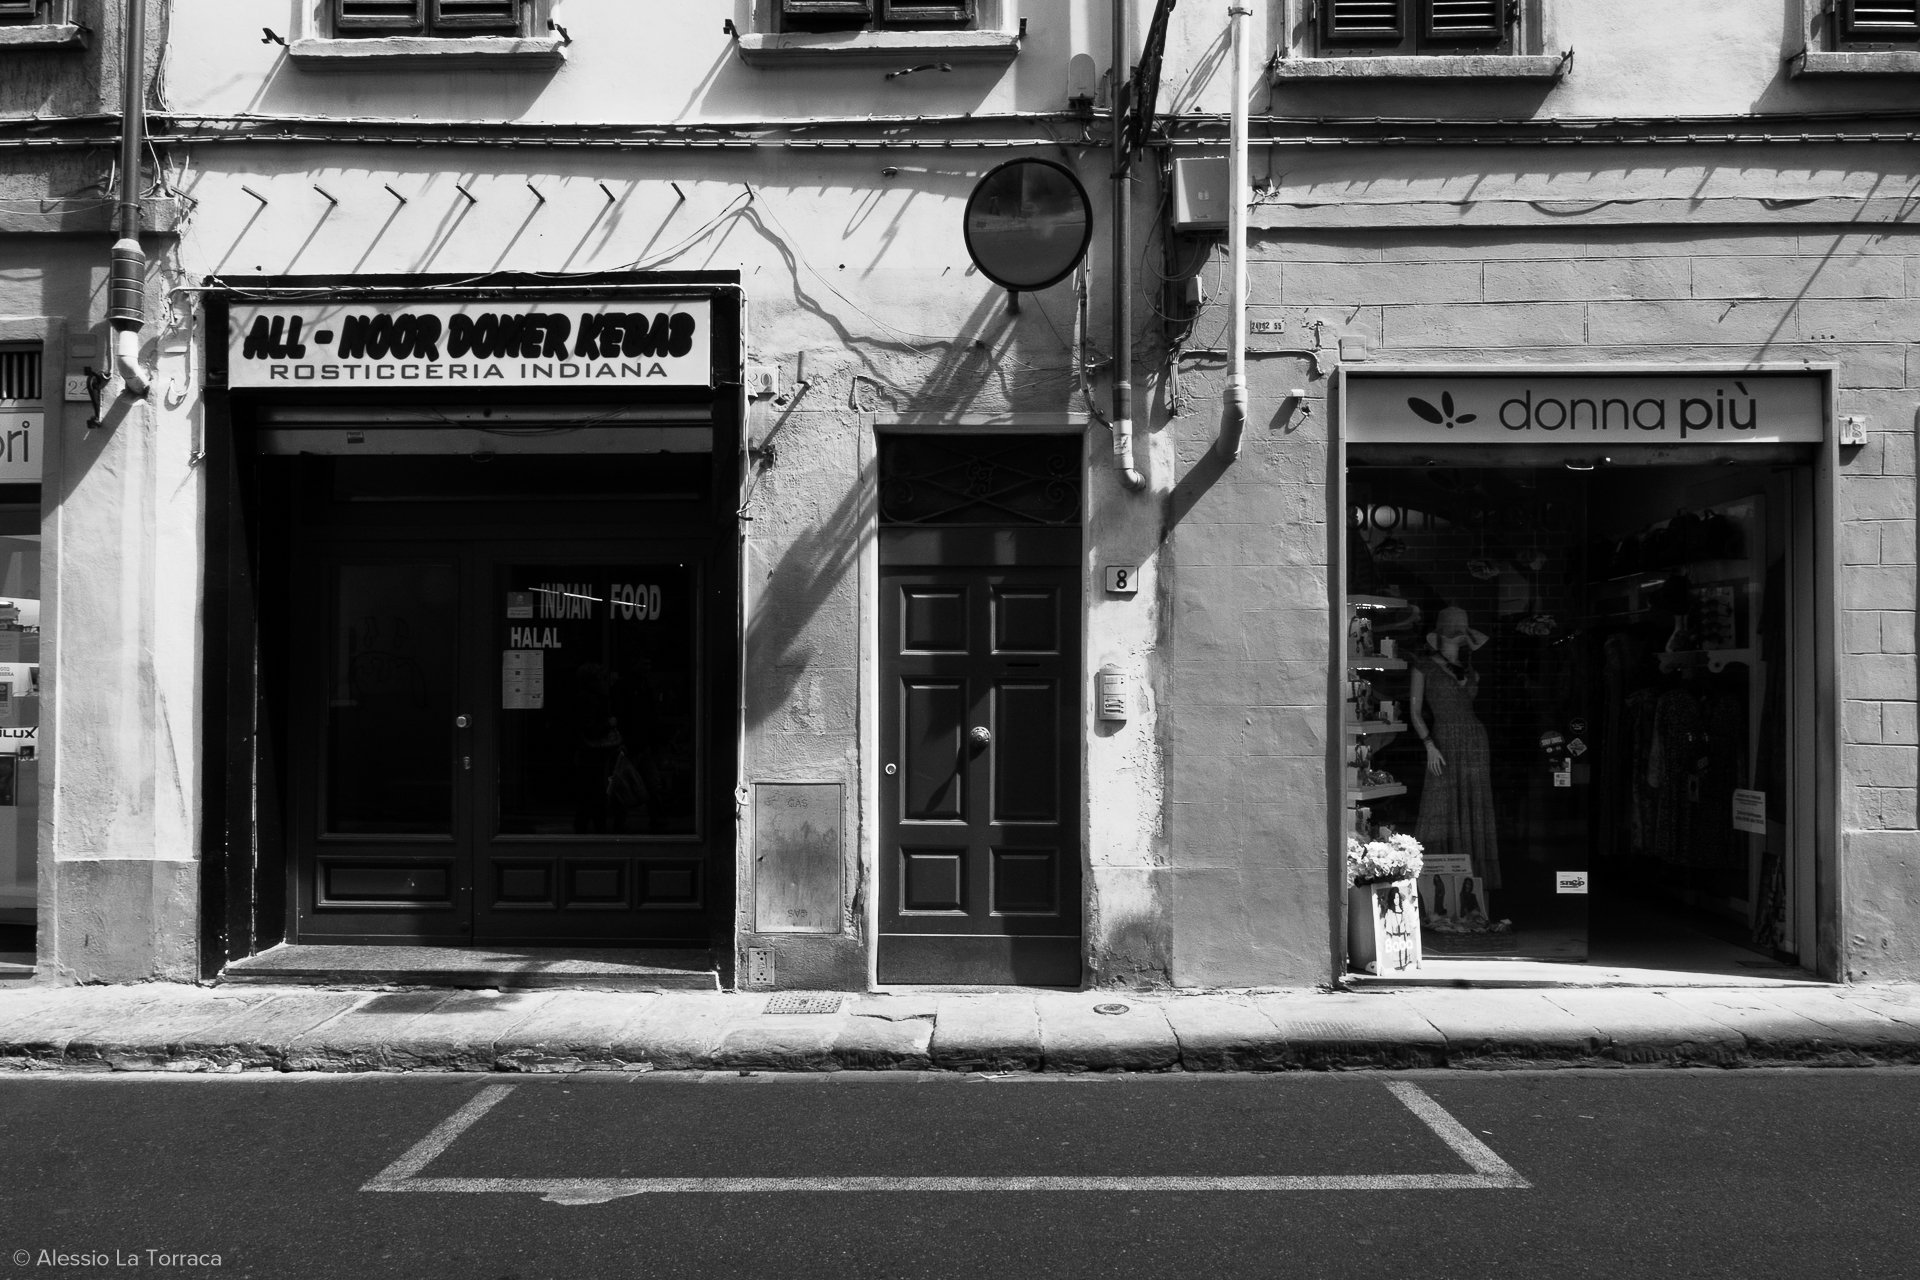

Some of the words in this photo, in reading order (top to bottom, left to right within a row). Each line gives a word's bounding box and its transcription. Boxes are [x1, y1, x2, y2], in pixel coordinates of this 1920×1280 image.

[243, 315, 306, 360] ALL
[338, 313, 442, 362] NOOR
[574, 312, 696, 361] KEBAB
[270, 364, 505, 380] ROSTICCERIA
[521, 362, 668, 379] INDIANA
[1498, 389, 1666, 431] donna
[1679, 381, 1757, 439] più
[0, 420, 30, 463] ri
[1116, 569, 1127, 589] 8
[540, 582, 592, 619] INDIAN
[610, 583, 662, 621] FOOD
[510, 626, 562, 648] HALAL
[787, 799, 808, 808] GAS
